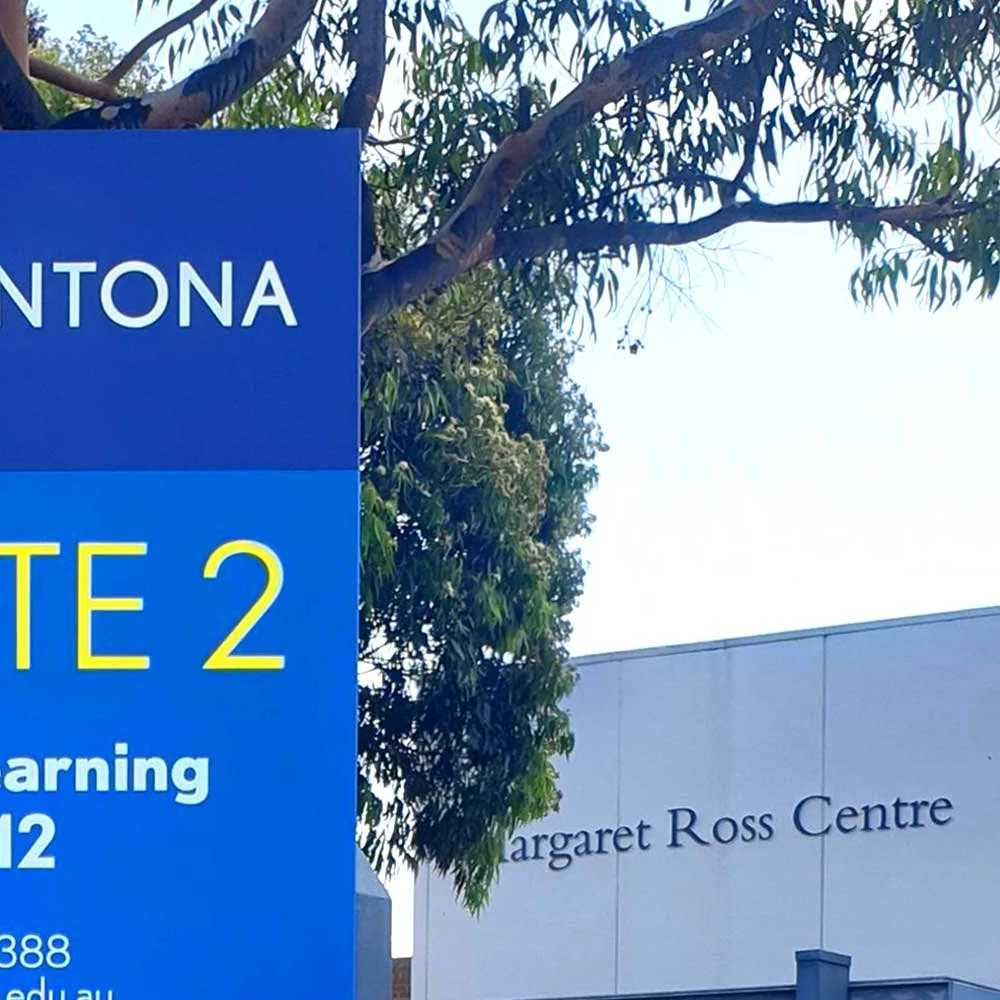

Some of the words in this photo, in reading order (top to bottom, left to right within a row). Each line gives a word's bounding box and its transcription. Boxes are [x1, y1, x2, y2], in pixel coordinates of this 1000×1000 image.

[202, 538, 286, 670] 2
[501, 818, 651, 872] argaret
[666, 806, 774, 849] Ross
[793, 795, 953, 837] Centre
